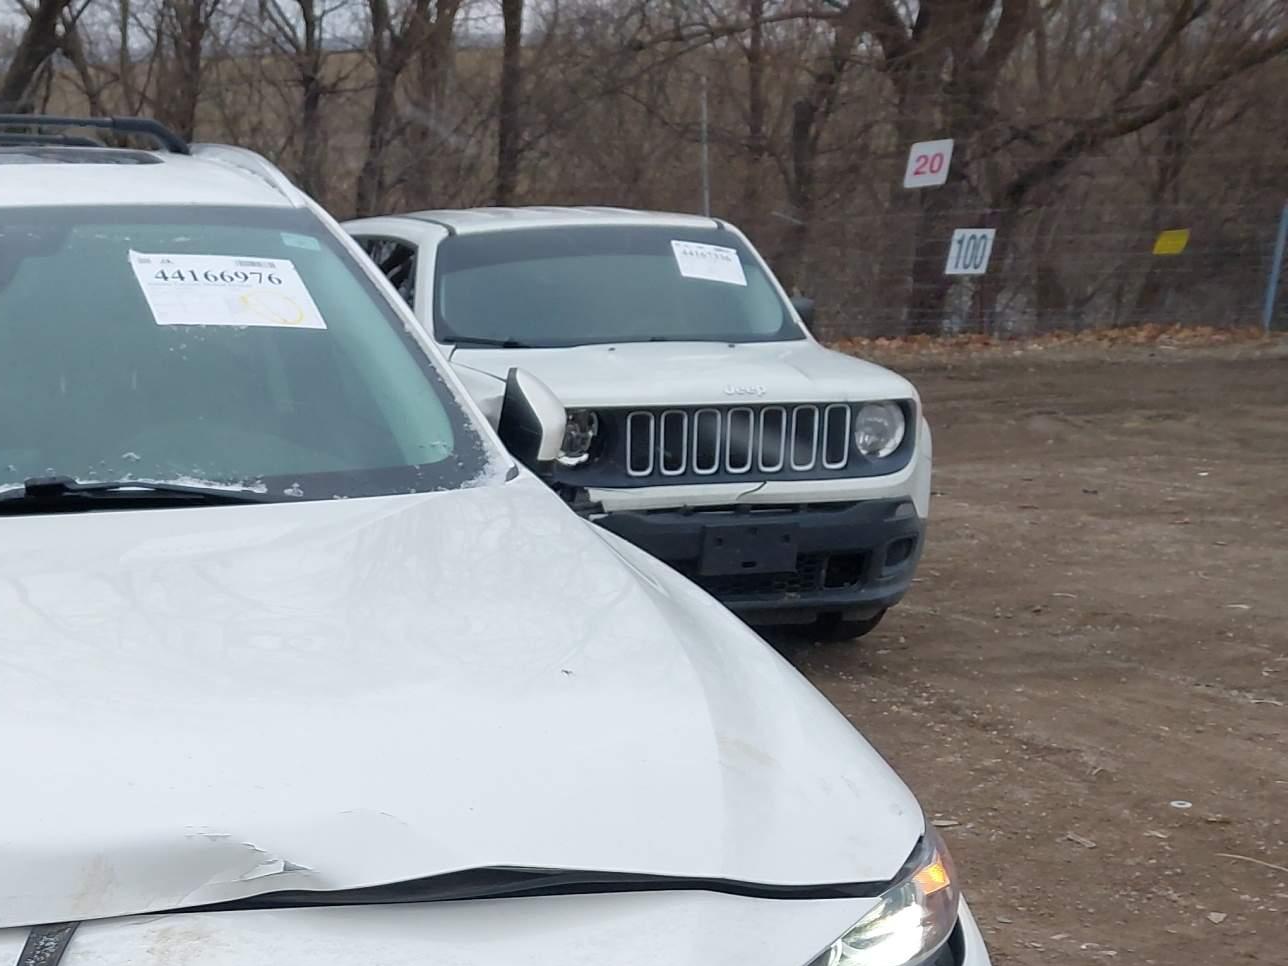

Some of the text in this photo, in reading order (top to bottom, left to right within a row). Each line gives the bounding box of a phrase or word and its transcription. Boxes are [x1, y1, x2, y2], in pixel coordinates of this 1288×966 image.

[913, 152, 944, 176] 20
[953, 234, 987, 269] 100
[154, 268, 283, 286] 44166976
[724, 383, 768, 397] Jeep
